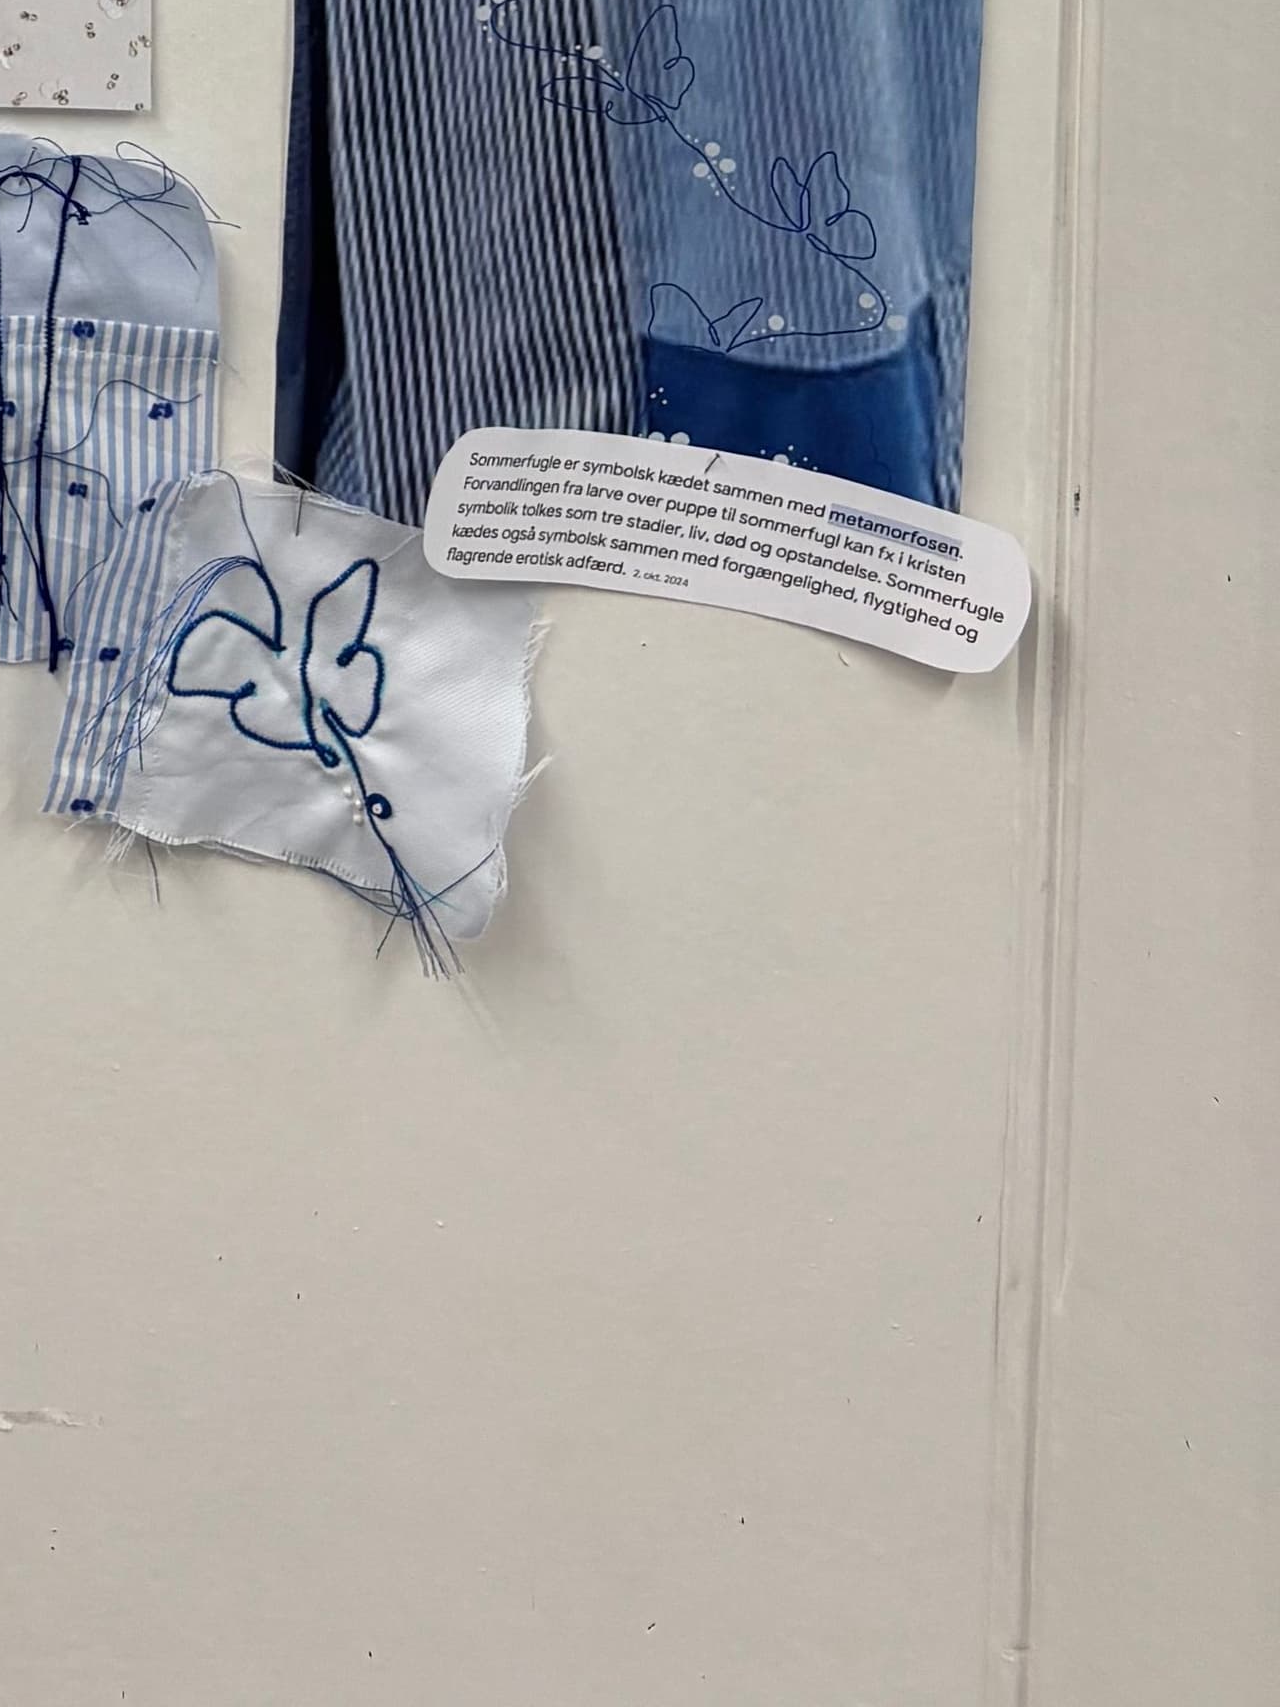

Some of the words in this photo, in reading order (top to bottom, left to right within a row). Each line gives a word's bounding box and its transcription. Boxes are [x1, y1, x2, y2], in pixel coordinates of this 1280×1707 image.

[463, 476, 561, 497] Forvandlingen
[563, 480, 584, 496] fra
[585, 483, 625, 502] larve
[626, 492, 665, 508] over
[664, 499, 718, 520] puppe
[721, 507, 738, 523] til
[738, 513, 842, 550] sommerfugl
[843, 535, 875, 557] kan
[878, 546, 896, 564] fx
[898, 551, 905, 566] i
[906, 554, 967, 586] kristen
[469, 452, 562, 473] Sommerfugle
[563, 459, 581, 471] er
[582, 461, 656, 483] symbolsk
[657, 469, 711, 493] kædet
[712, 483, 784, 508] sammen
[786, 500, 827, 519] med
[829, 509, 964, 560] metamorfosen.
[446, 547, 514, 567] flagrende
[515, 551, 565, 568] erotisk
[565, 555, 627, 576] adfærd.
[451, 523, 500, 540] kædes
[501, 525, 537, 545] også
[537, 529, 609, 548] symbolsk
[609, 538, 680, 561] sammen
[681, 552, 720, 569] med
[722, 556, 859, 604] forgængelighed,
[863, 591, 953, 632] flygtighed
[955, 624, 979, 644] og
[457, 500, 520, 518] symbolik
[522, 502, 564, 519] tolkes
[565, 508, 598, 522] som
[601, 510, 624, 526] tre
[626, 516, 685, 539] stadier,
[688, 524, 710, 544] liv,
[713, 531, 748, 550] død
[750, 541, 773, 559] og
[775, 547, 883, 584] opstandelse.
[885, 573, 1005, 624] Sommerfugle
